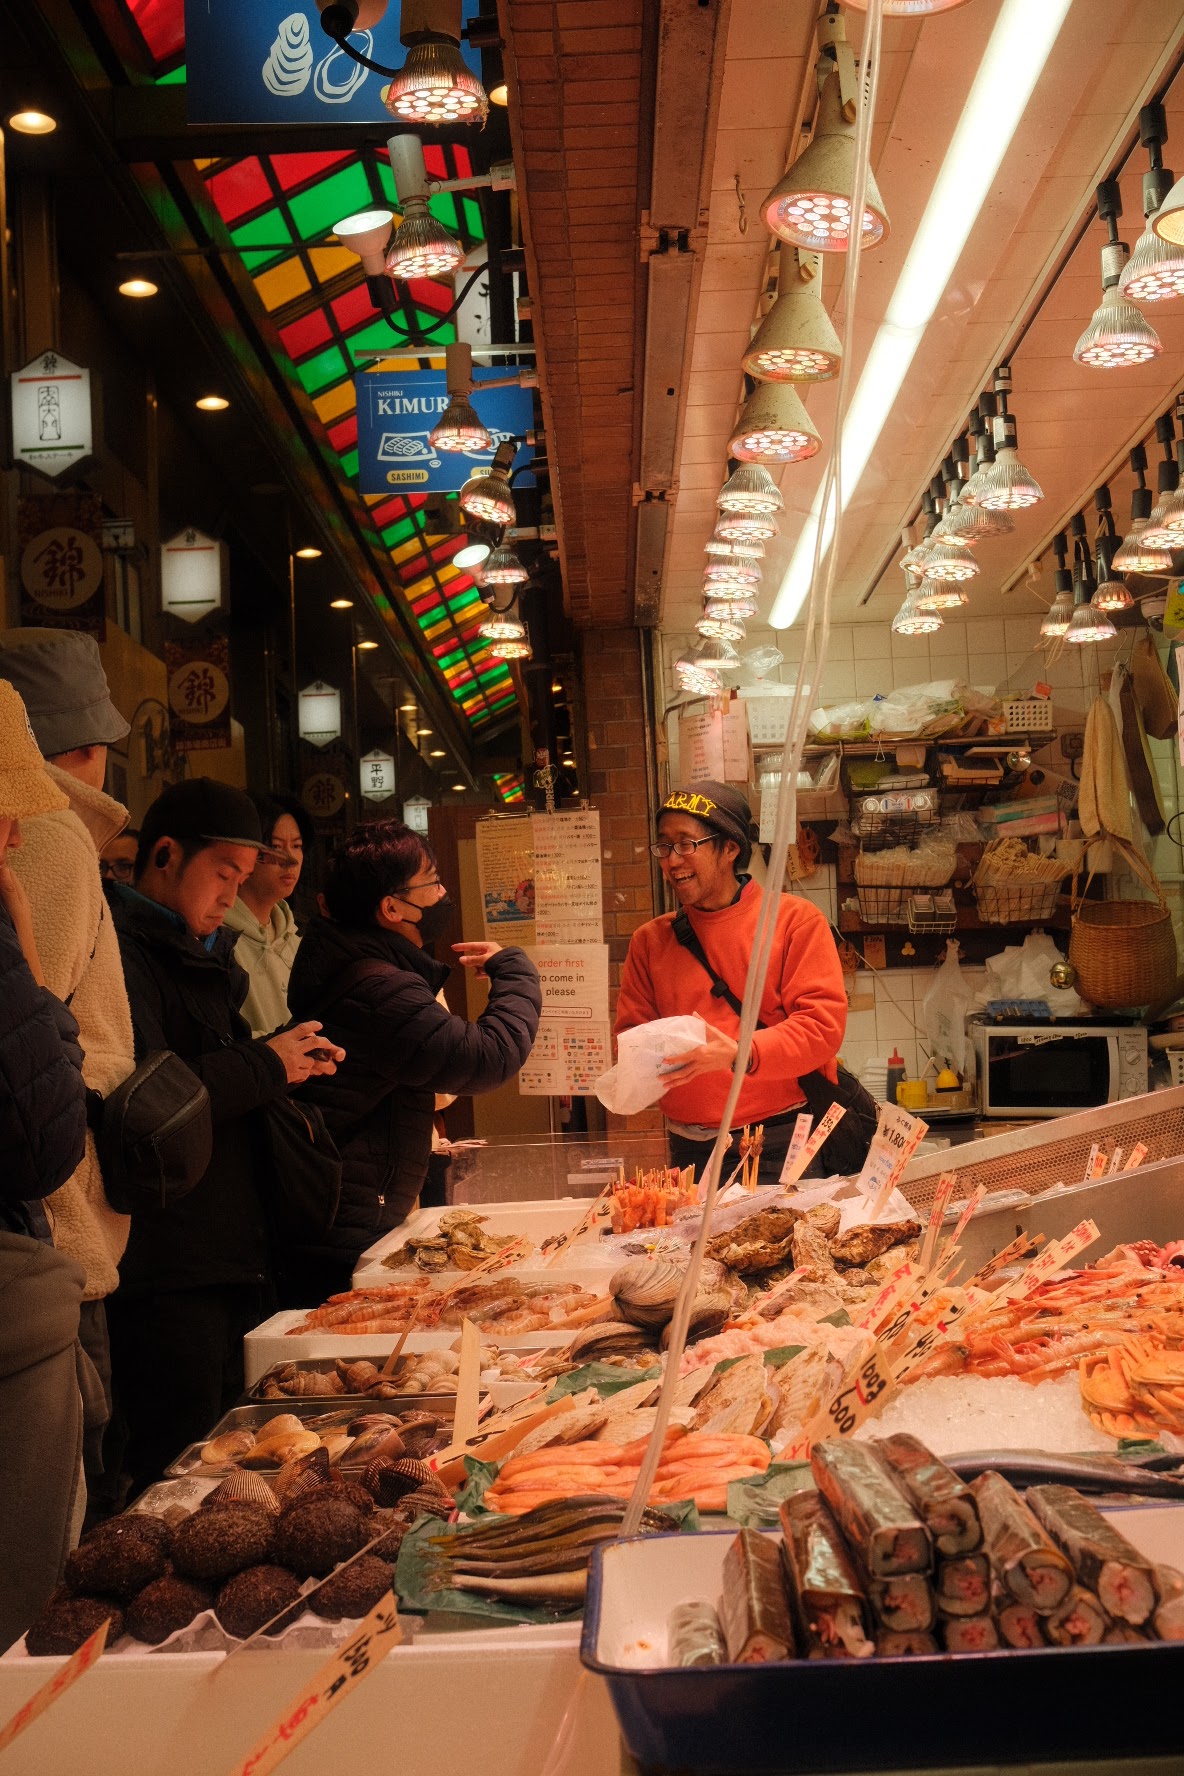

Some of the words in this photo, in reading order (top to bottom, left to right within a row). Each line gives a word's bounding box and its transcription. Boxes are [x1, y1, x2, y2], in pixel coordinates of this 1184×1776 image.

[377, 396, 450, 415] KIMUR
[391, 471, 425, 481] SASHIMI
[33, 536, 87, 599] 錦
[177, 668, 217, 715] 錦
[370, 763, 385, 789] 平野
[663, 790, 718, 818] ARMY
[538, 958, 563, 968] order
[564, 958, 585, 968] first
[538, 974, 547, 983] to
[576, 973, 585, 982] in
[546, 987, 576, 997] please
[828, 1104, 844, 1119] EEL
[860, 1353, 887, 1405] 100g
[829, 1385, 857, 1434] 600
[338, 1633, 372, 1677] 1500
